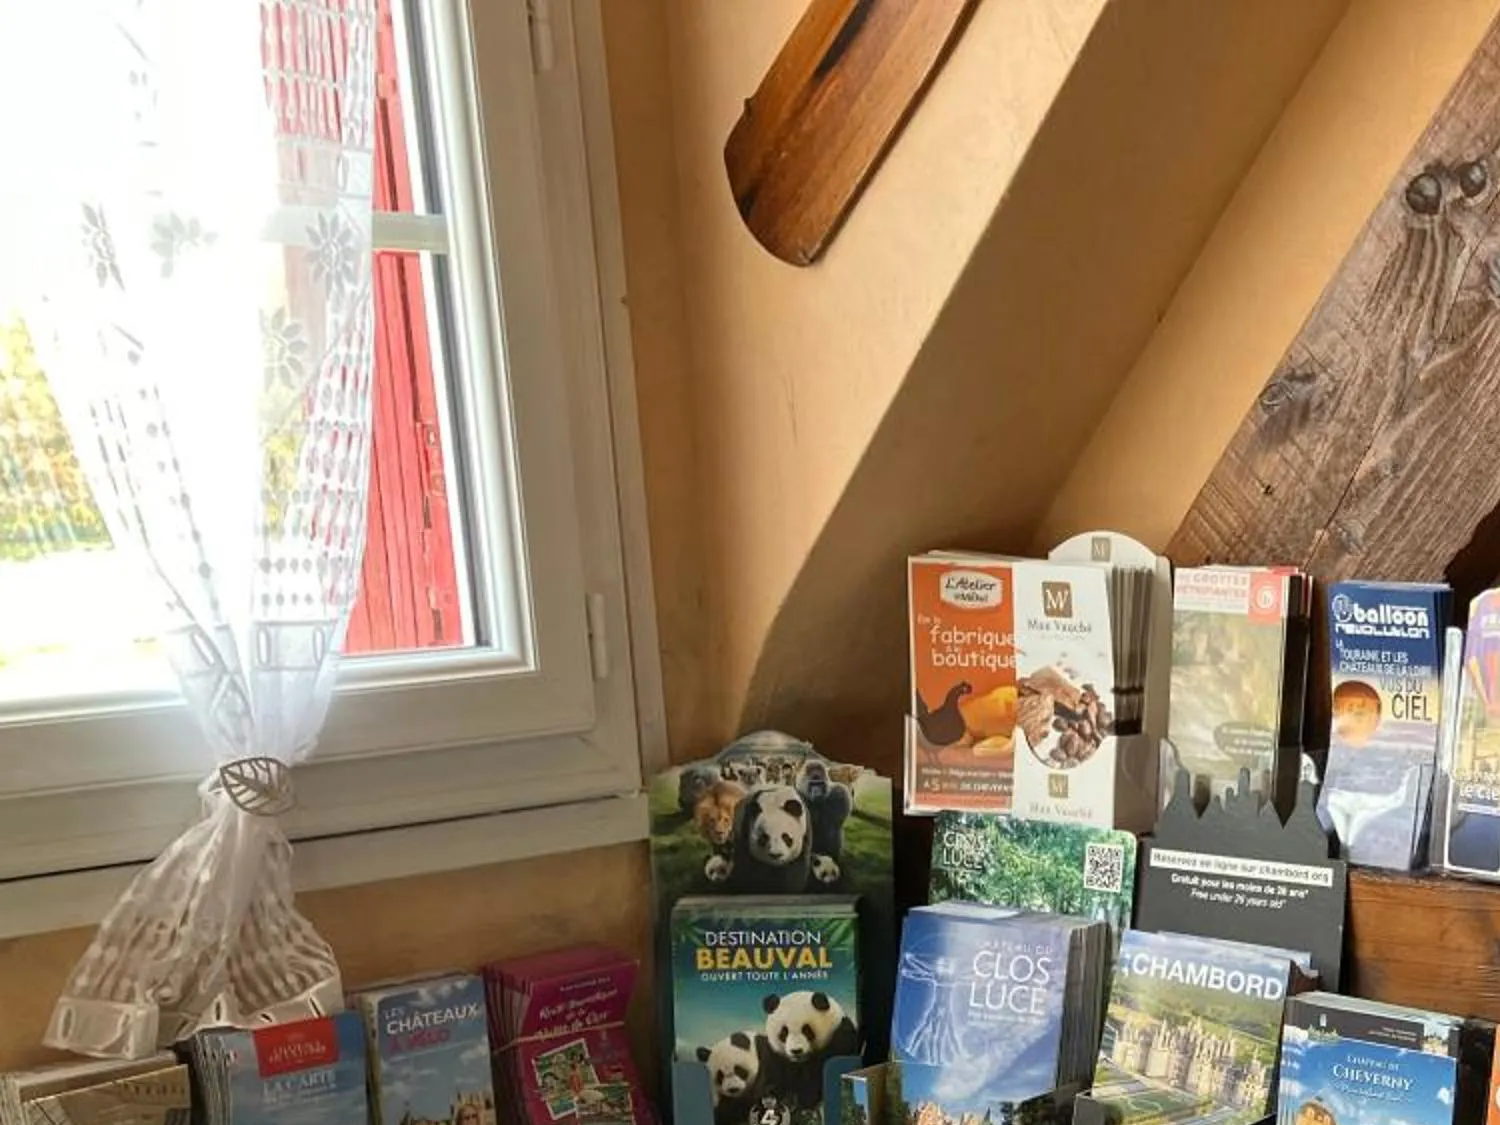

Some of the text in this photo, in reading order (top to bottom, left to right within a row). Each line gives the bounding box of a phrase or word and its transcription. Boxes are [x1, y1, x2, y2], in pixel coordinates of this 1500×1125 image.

[945, 576, 997, 592] L'Atelier
[1352, 602, 1428, 626] balloon
[929, 624, 1018, 648] fabrique
[931, 650, 1018, 673] boutique
[1390, 693, 1433, 721] CIEL
[1200, 877, 1220, 890] pour
[1221, 879, 1234, 889] les
[1235, 882, 1262, 894] moins
[1263, 884, 1275, 895] de
[1209, 891, 1233, 903] under
[704, 930, 822, 947] DESTINATION
[695, 947, 834, 971] BEAUVAL
[973, 949, 1053, 986] CLOS
[700, 971, 743, 982] OUVERT
[745, 970, 780, 981] TOUTE
[1131, 951, 1284, 1001] CHAMBORD
[385, 1001, 481, 1036] CHÂTEAUX
[1332, 1063, 1415, 1091] CHEVERNY
